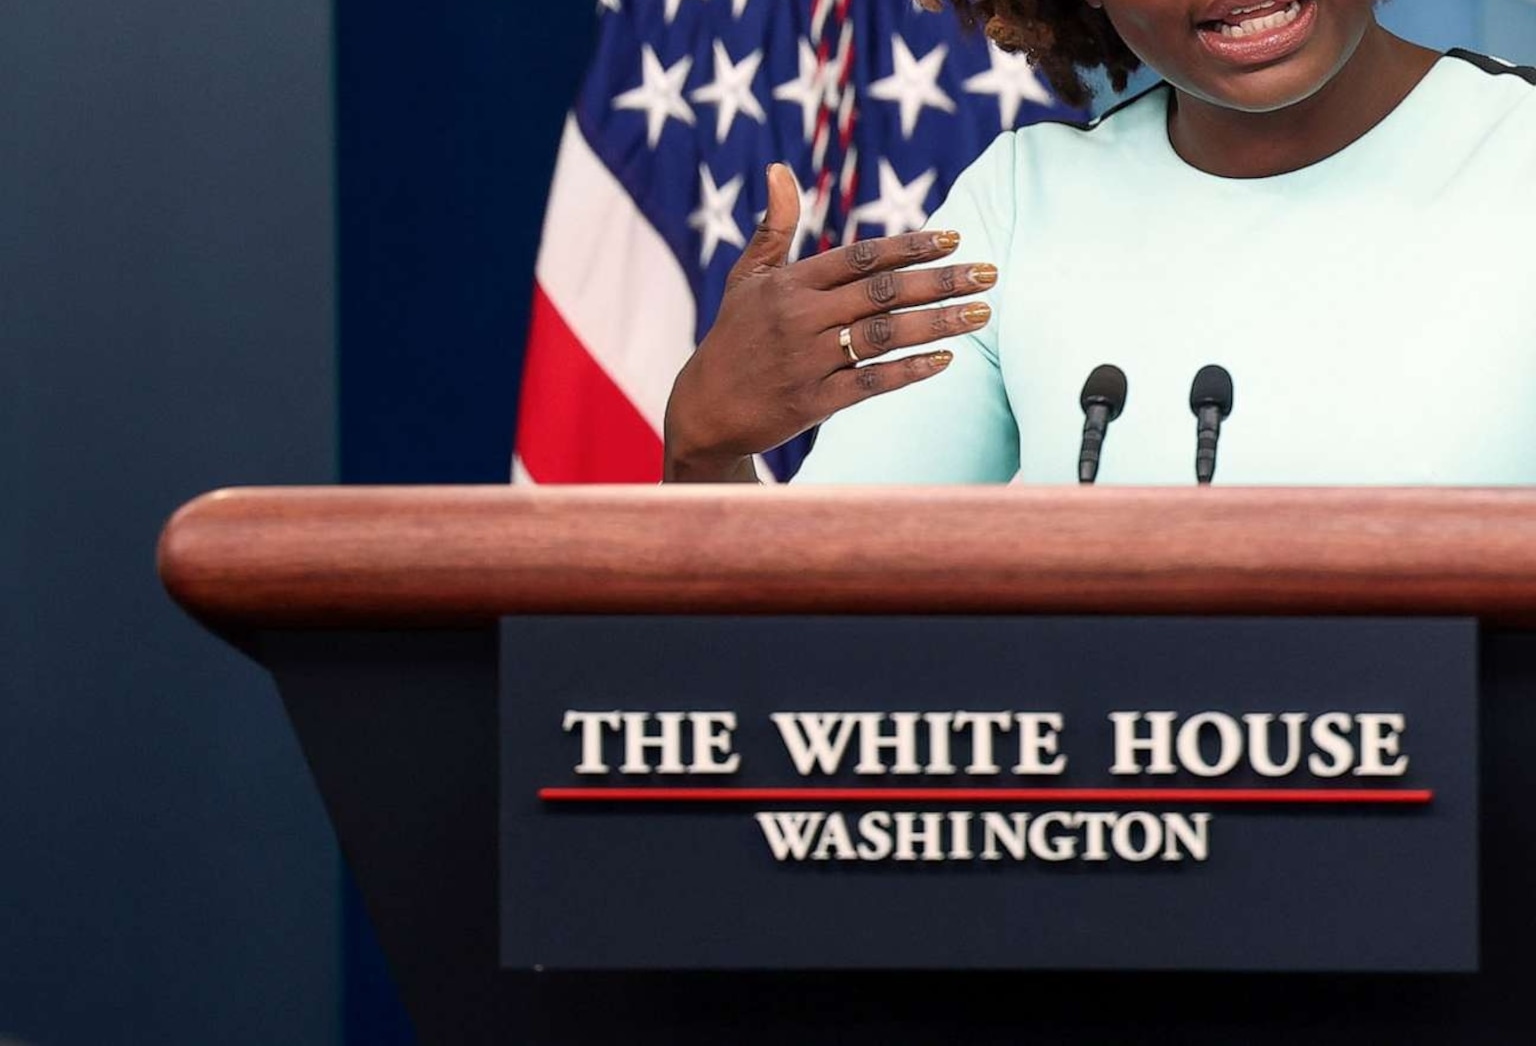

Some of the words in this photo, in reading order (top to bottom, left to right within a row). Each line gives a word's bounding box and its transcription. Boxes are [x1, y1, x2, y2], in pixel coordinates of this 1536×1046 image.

[562, 710, 740, 774] THE
[770, 710, 1067, 777] WHITE
[1109, 711, 1409, 778] HOUSE
[756, 811, 1211, 862] WASHINGTON
